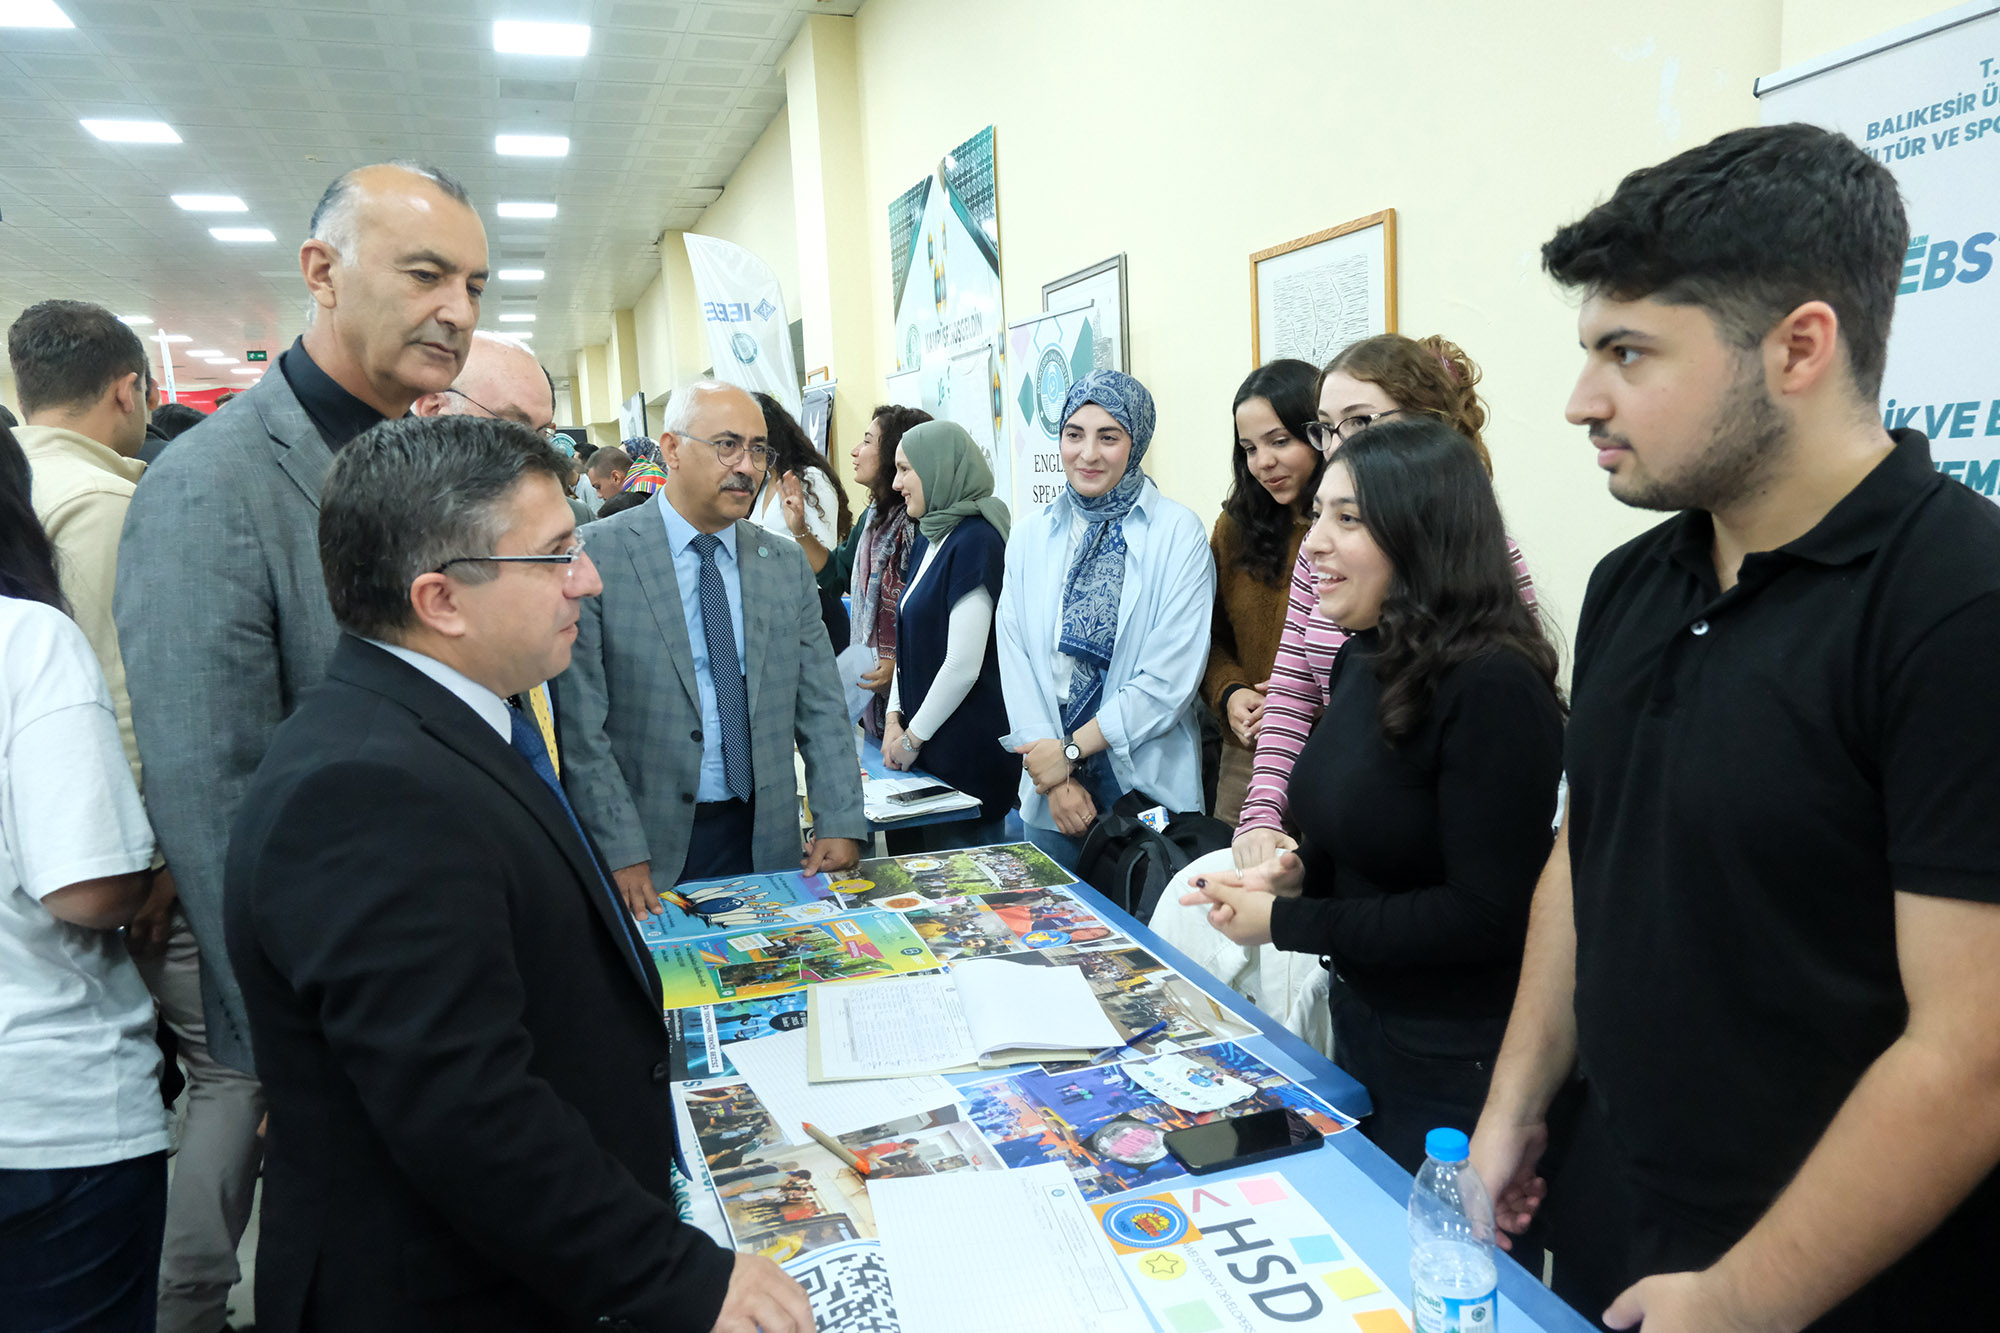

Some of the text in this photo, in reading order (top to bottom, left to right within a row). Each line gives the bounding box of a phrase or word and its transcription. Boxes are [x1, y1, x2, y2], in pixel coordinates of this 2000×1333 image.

[1866, 82, 2000, 141] BALIKESİR Ü
[1931, 126, 1960, 151] VE
[1925, 401, 1981, 440] VE
[1034, 453, 1066, 473] ENGL
[1933, 459, 2000, 496] EM
[1192, 1257, 1224, 1288] STUDENT
